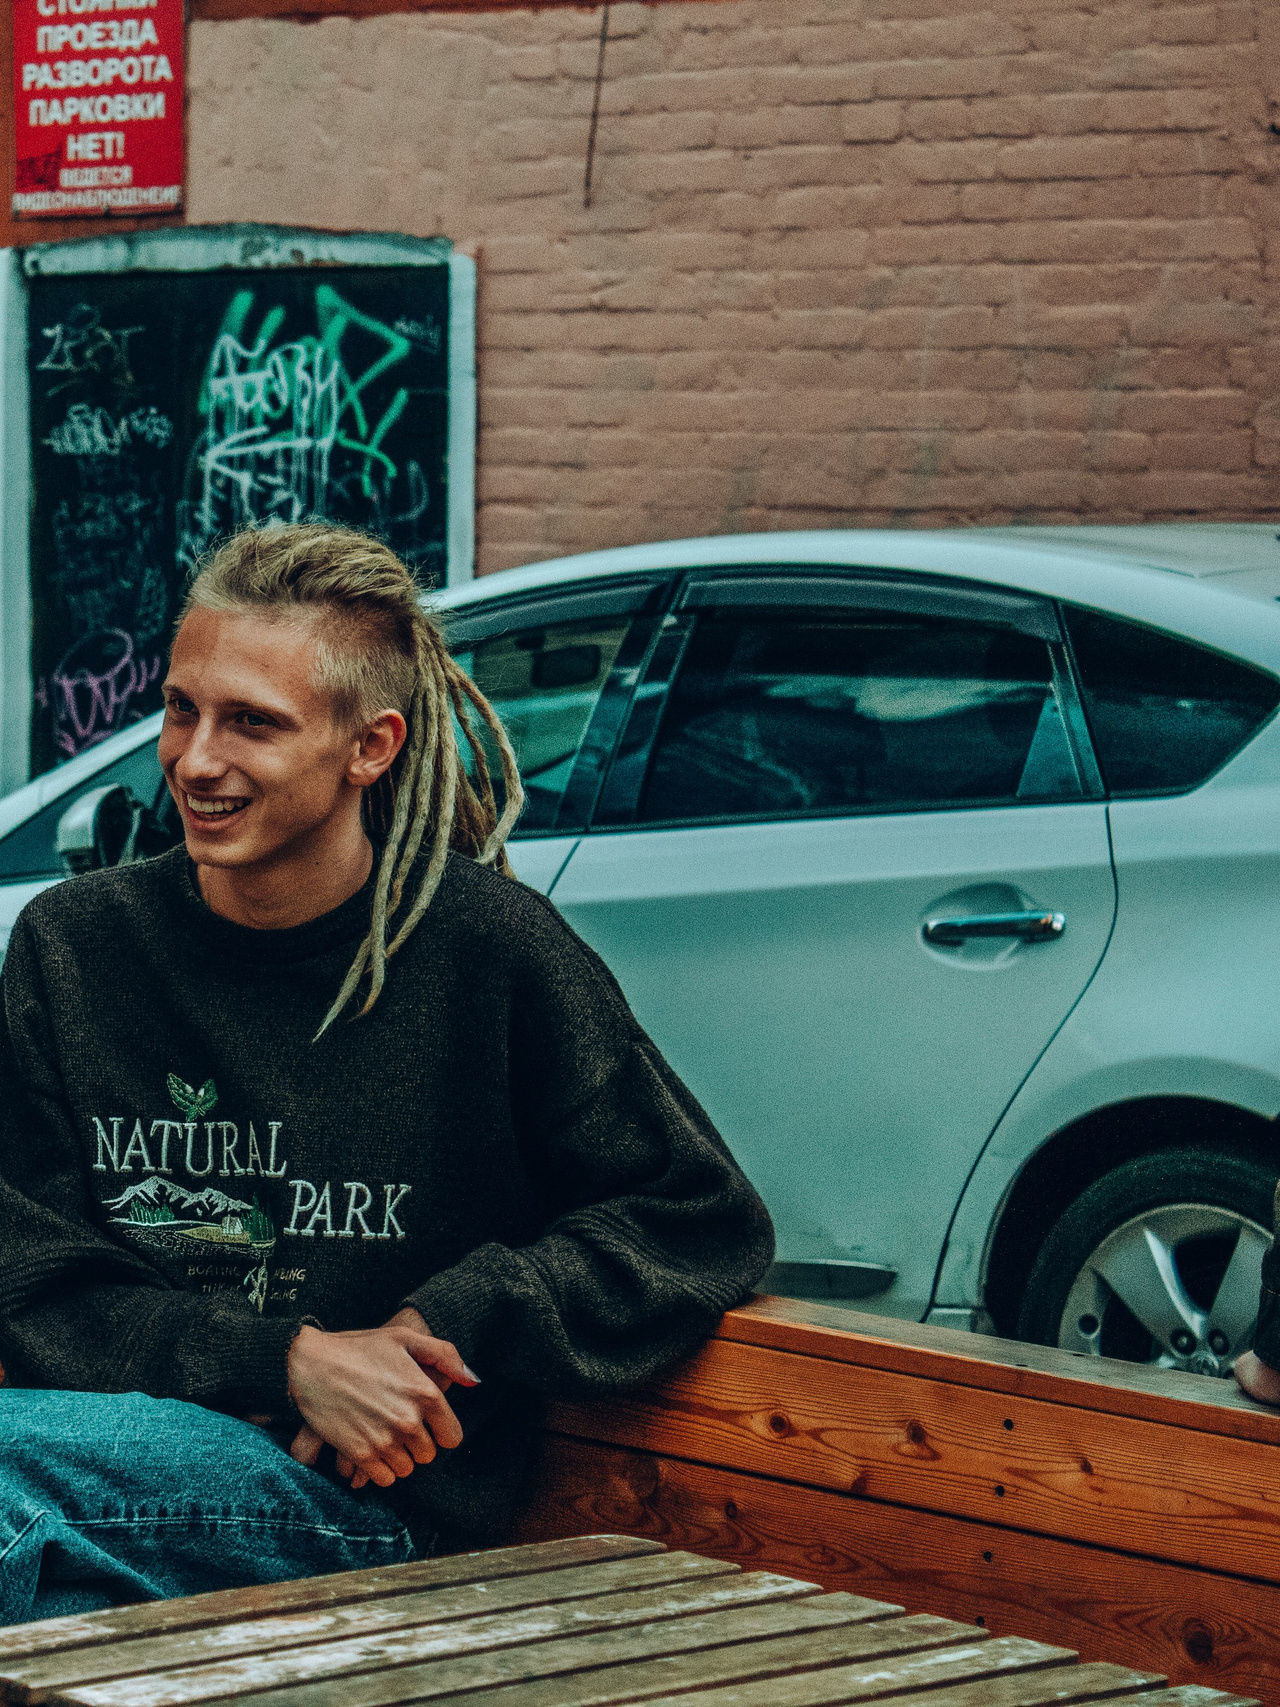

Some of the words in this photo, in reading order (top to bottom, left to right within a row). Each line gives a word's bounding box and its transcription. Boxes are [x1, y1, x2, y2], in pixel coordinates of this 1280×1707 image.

[36, 18, 160, 53] ПРОЕЗДА
[21, 54, 174, 91] РАЗВОРОТА
[28, 91, 166, 127] ПАРКОВКИ
[66, 131, 125, 161] НЕТ!
[91, 1116, 289, 1178] NATURAL
[283, 1179, 413, 1240] PARK
